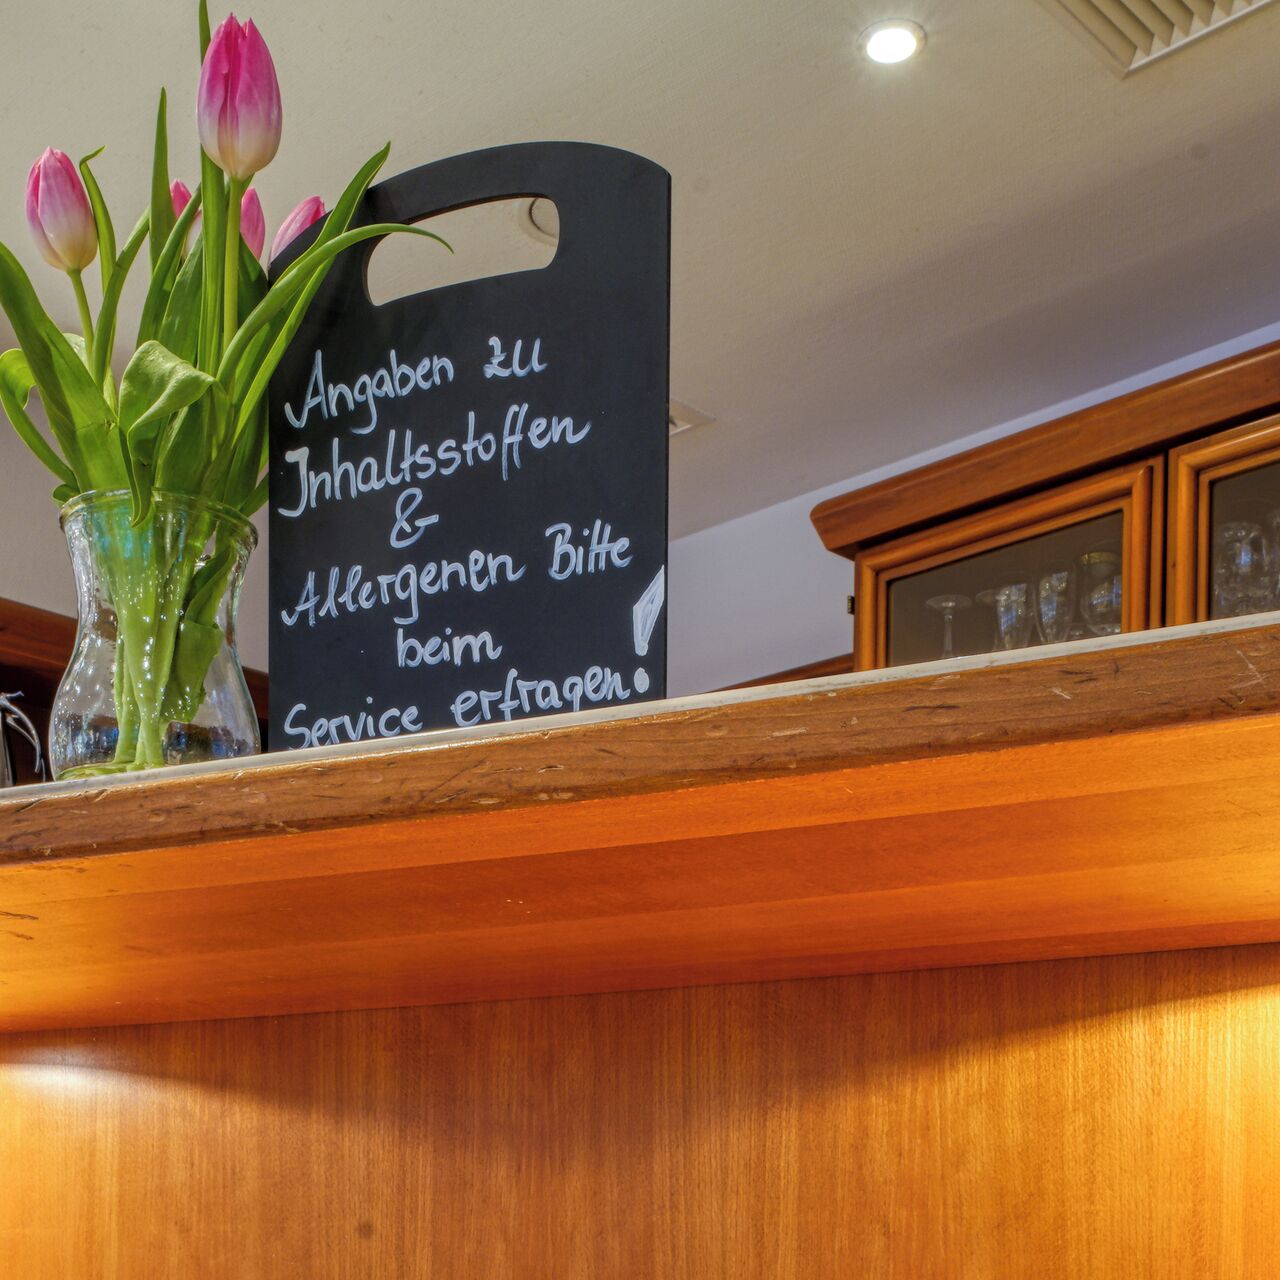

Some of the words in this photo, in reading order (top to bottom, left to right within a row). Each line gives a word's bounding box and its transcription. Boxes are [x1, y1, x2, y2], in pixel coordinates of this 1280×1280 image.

[285, 350, 454, 433] Angaben
[390, 487, 439, 549] &
[281, 549, 526, 626] Allergenen
[545, 519, 633, 581] Bitte
[397, 627, 502, 668] beim
[283, 697, 423, 751] Service
